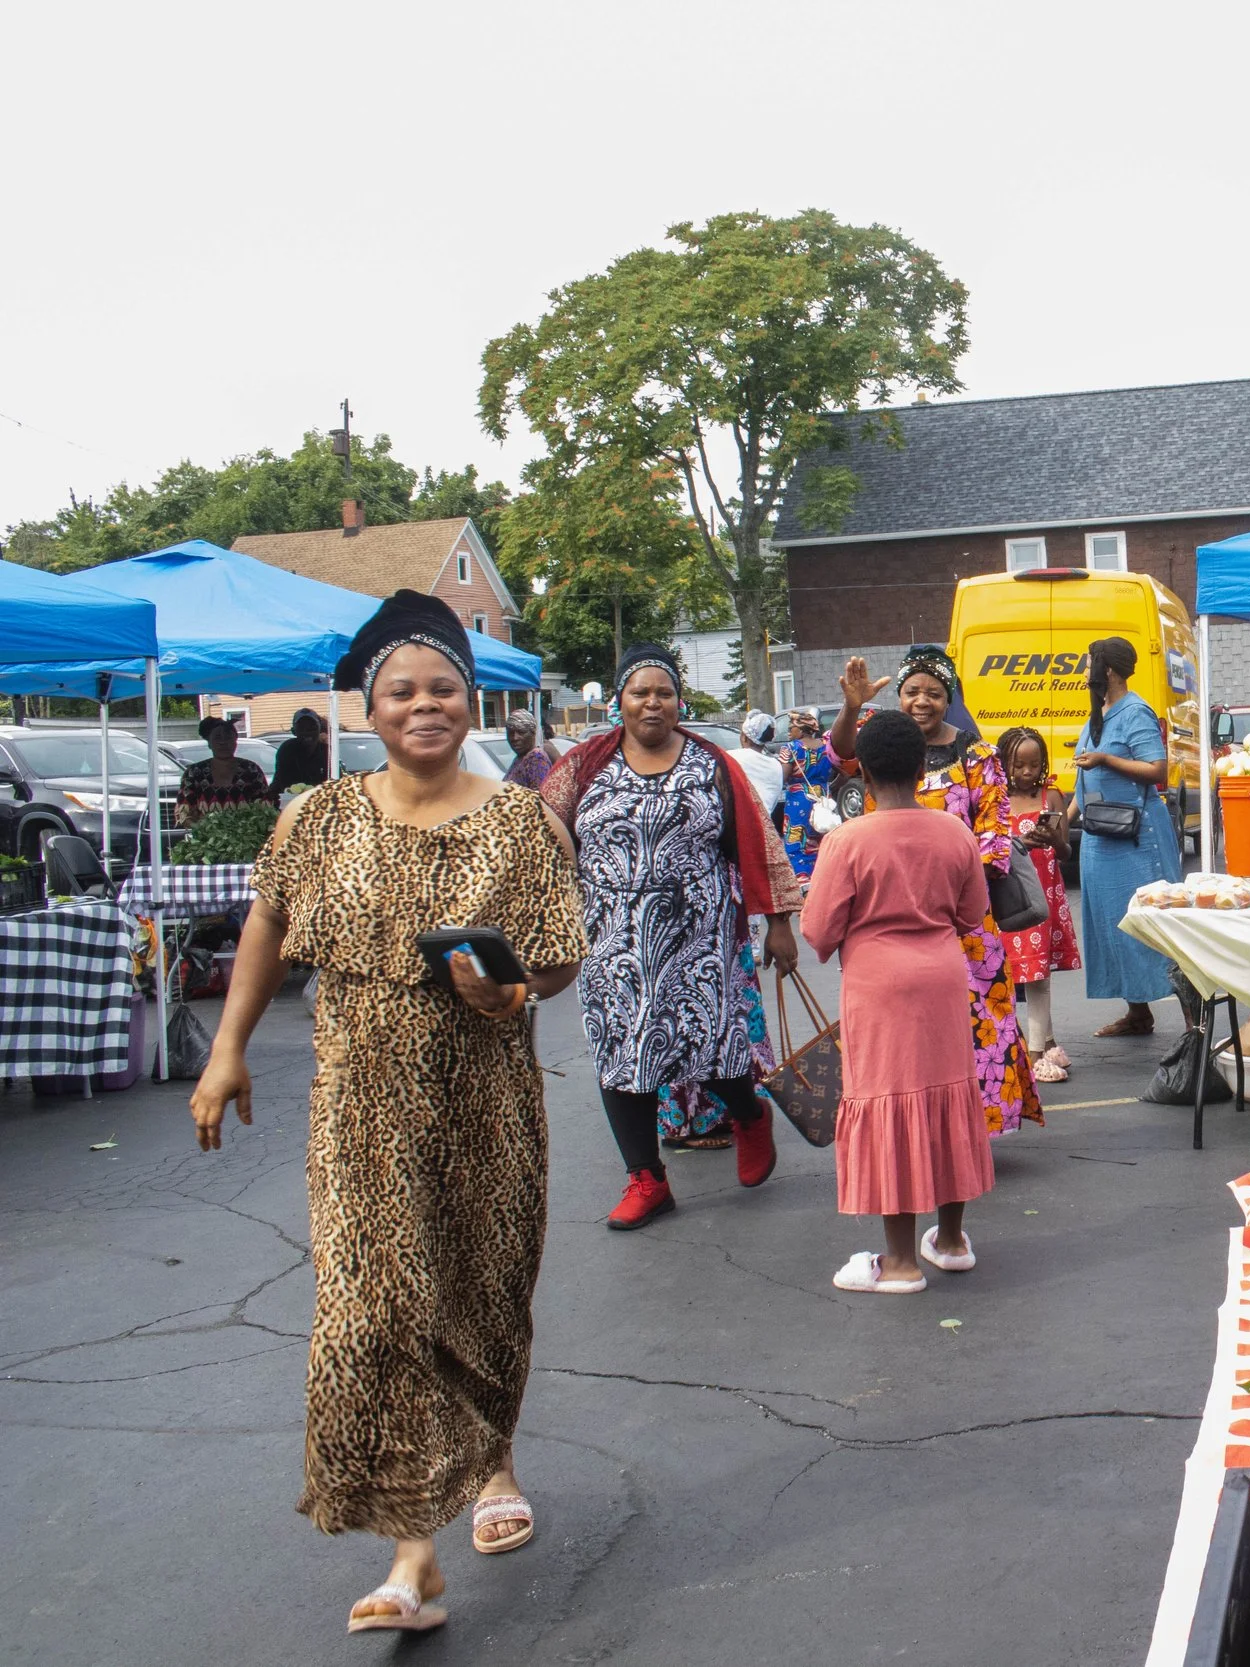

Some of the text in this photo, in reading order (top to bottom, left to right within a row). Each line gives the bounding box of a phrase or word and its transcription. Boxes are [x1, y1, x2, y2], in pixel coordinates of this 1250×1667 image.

[978, 653, 1089, 676] PENS
[1009, 679, 1089, 692] Truck Renta
[977, 708, 1029, 720] Household
[1030, 708, 1038, 718] &
[1041, 707, 1087, 718] Business
